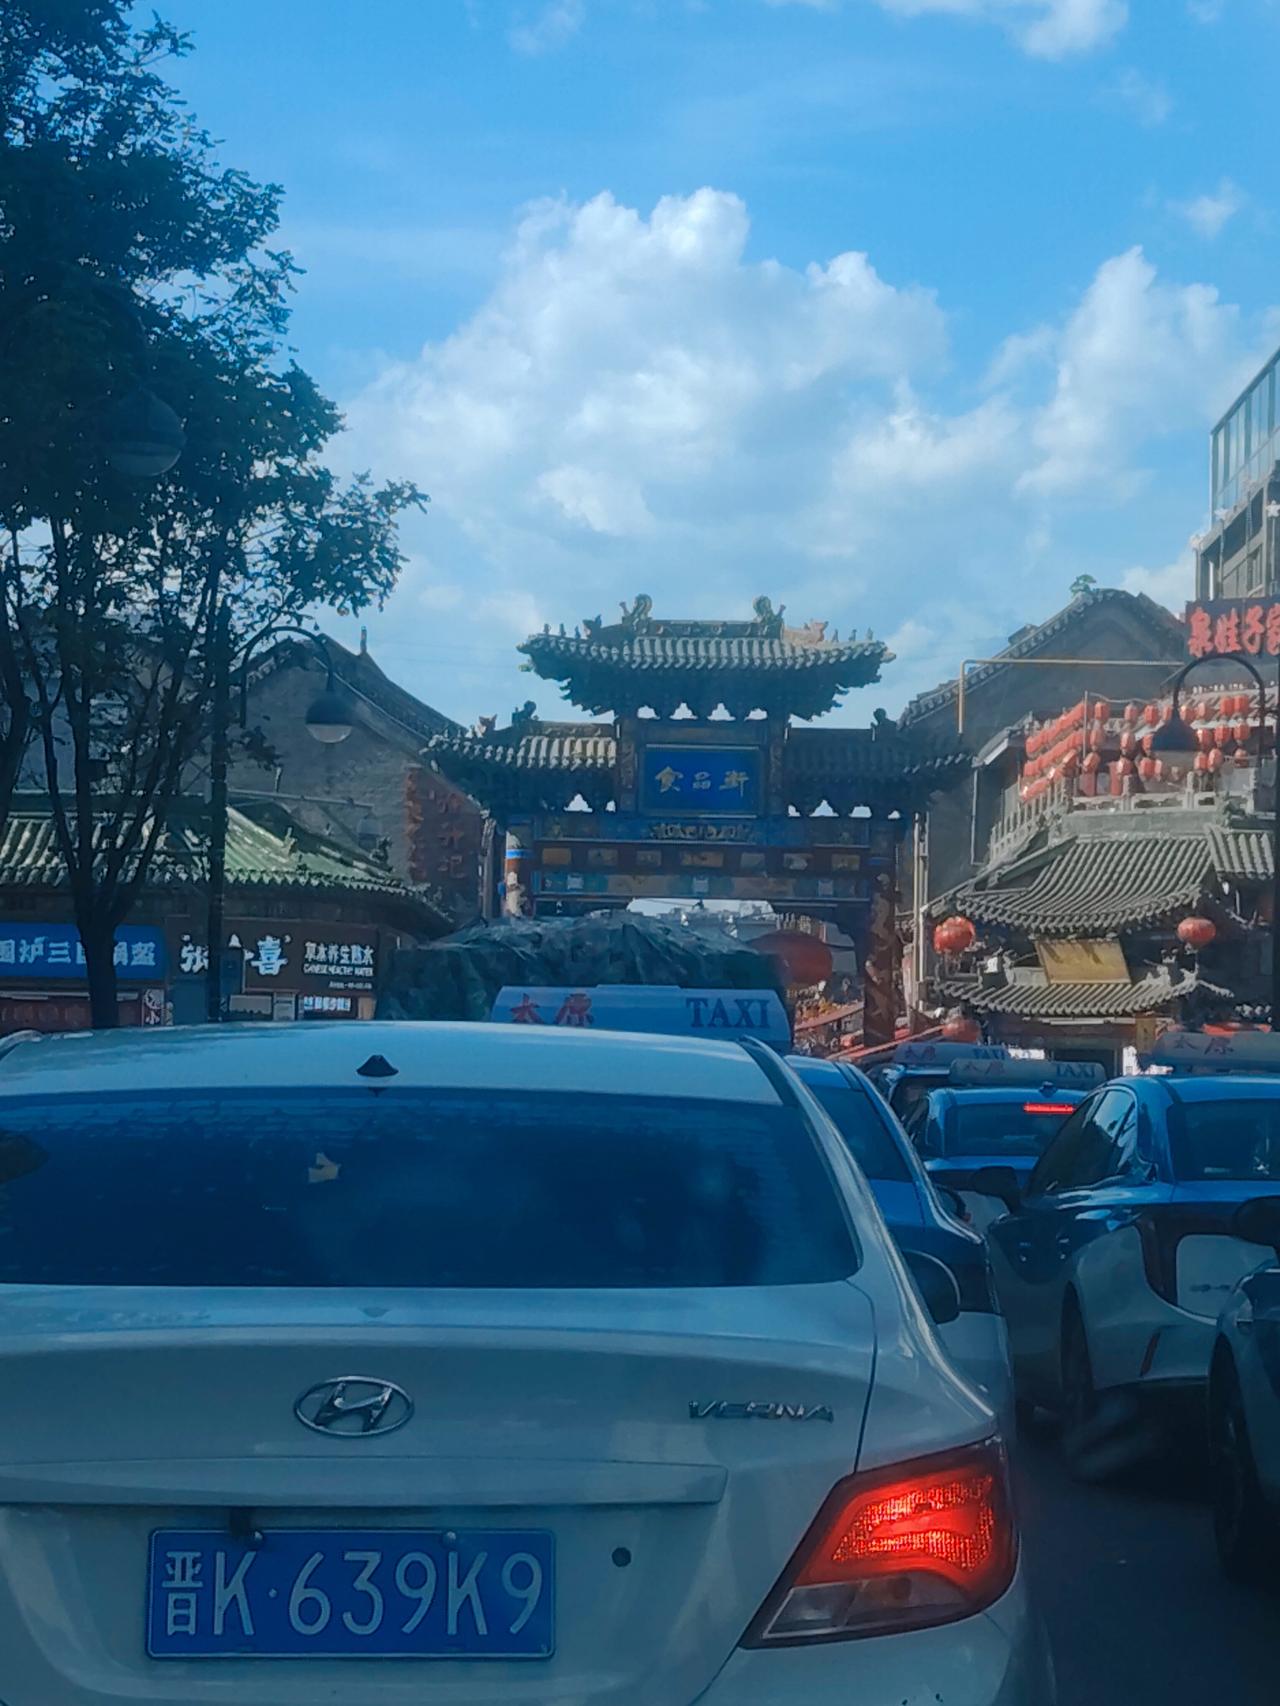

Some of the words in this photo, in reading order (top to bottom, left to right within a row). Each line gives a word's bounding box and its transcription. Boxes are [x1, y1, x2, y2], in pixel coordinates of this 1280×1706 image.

[180, 934, 289, 975] 张喜
[510, 992, 594, 1027] 太原
[686, 997, 770, 1028] TAXI
[1174, 1035, 1235, 1056] 太原
[1055, 1063, 1095, 1077] TAXI
[688, 1400, 834, 1423] VERNA
